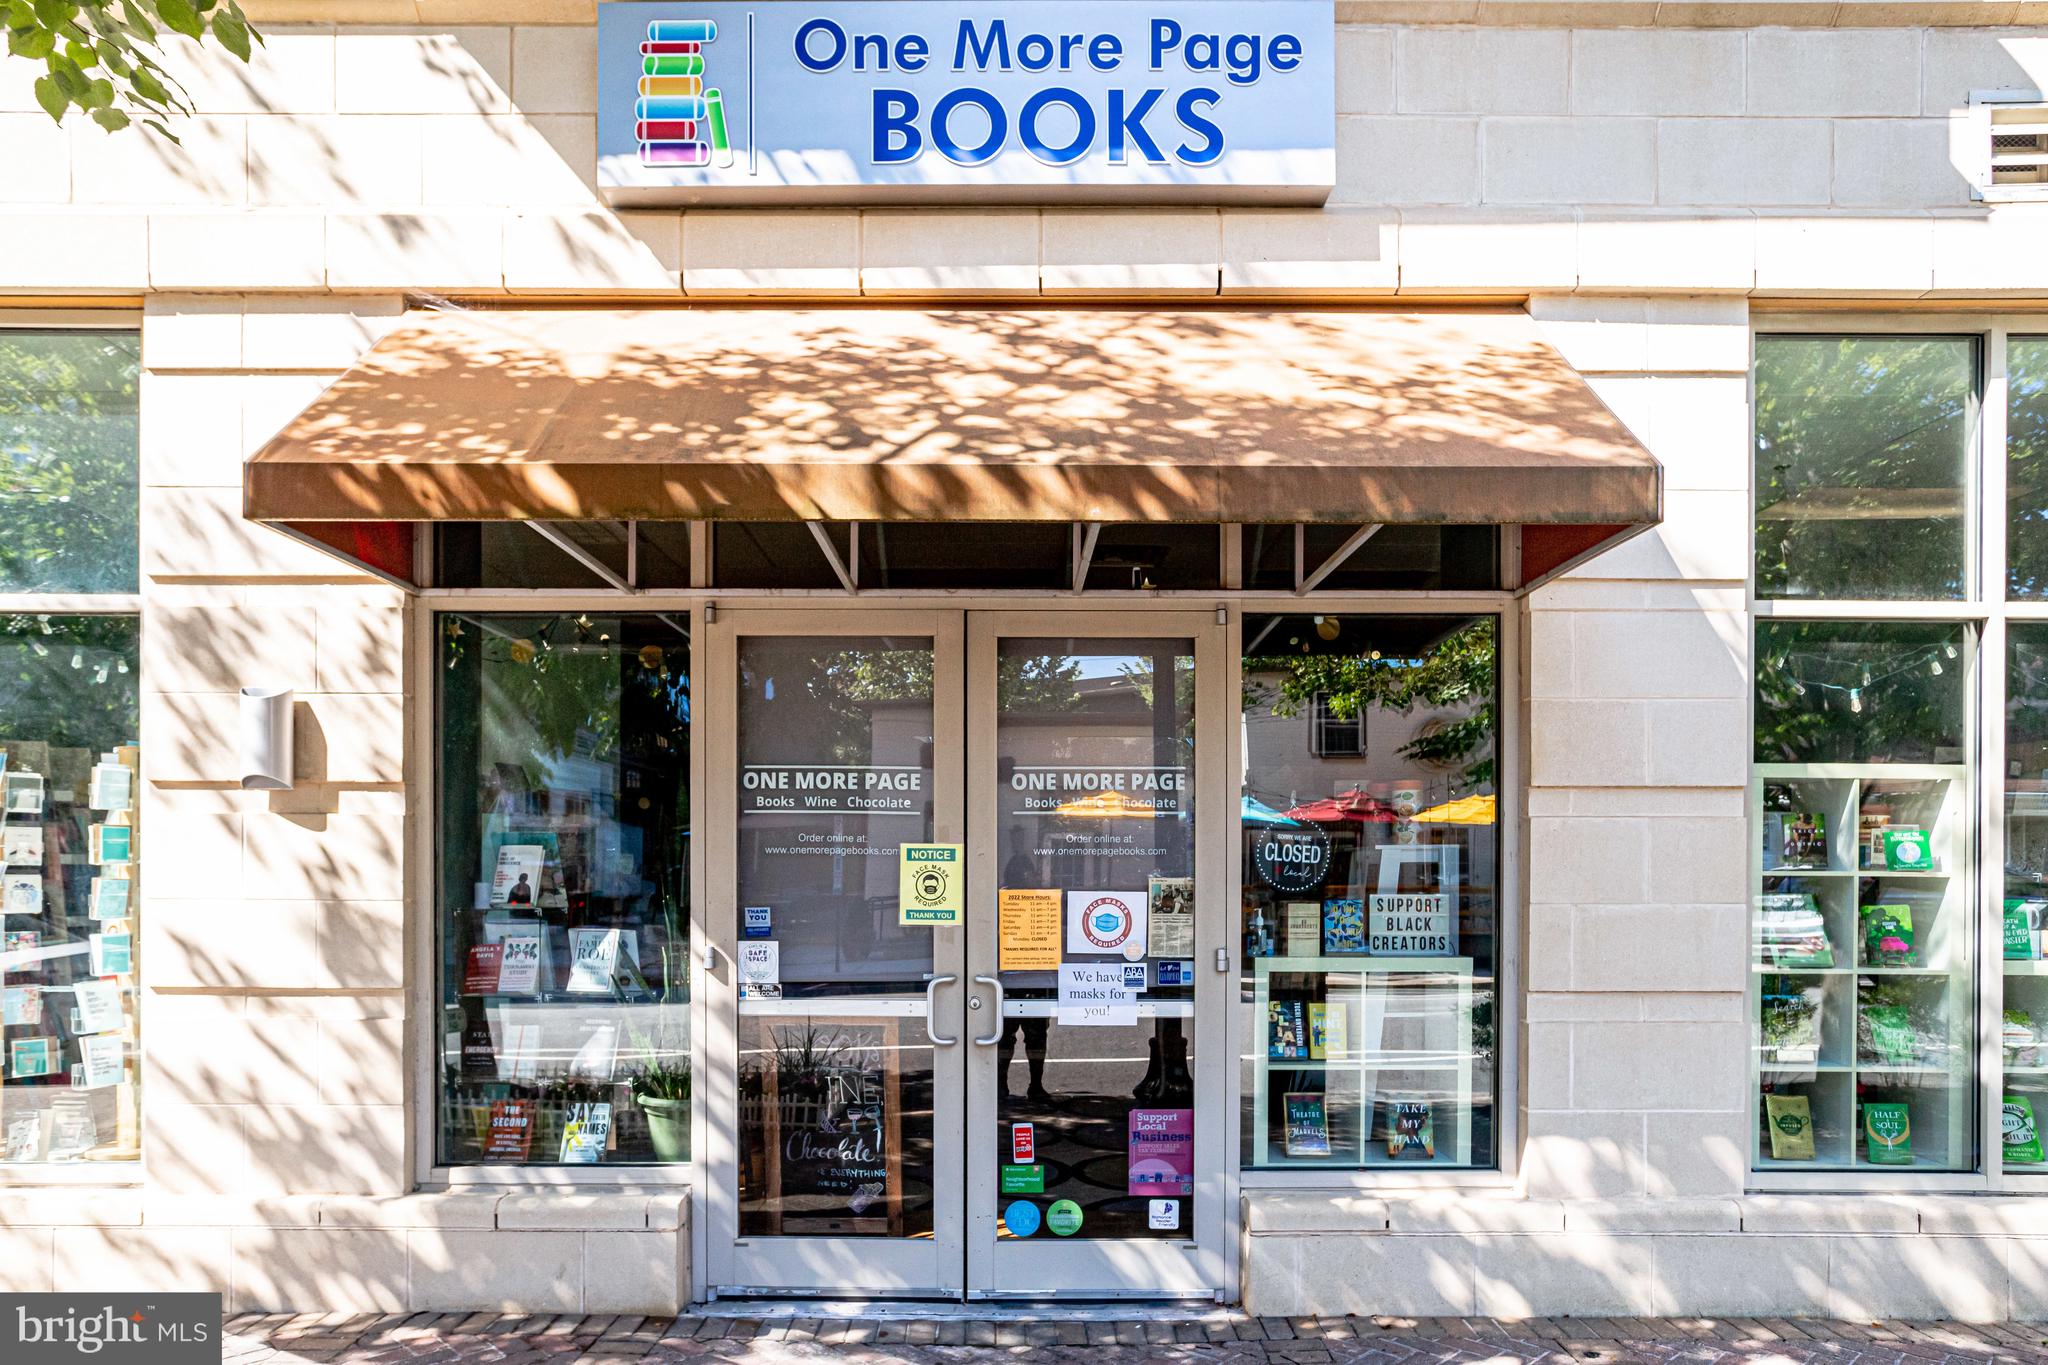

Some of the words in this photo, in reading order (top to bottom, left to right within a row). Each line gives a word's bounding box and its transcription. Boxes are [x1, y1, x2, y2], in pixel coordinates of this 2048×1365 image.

[794, 17, 931, 73] One
[952, 18, 1125, 73] More
[1148, 17, 1305, 86] Page
[870, 86, 1227, 167] BOOKS
[743, 772, 789, 790] ONE
[795, 772, 858, 790] MORE
[865, 773, 921, 791] PAGE
[1011, 773, 1056, 791] ONE
[1063, 773, 1125, 791] MORE
[1131, 773, 1186, 791] PAGE
[756, 796, 795, 807] Books
[804, 796, 837, 807] Wine
[847, 797, 911, 808] Chocolate
[1025, 797, 1062, 808] Books
[1072, 797, 1105, 808] Wine
[1115, 797, 1177, 808] Chocolate
[798, 833, 825, 843] Order
[826, 834, 854, 843] online
[1066, 834, 1092, 843] Order
[1094, 834, 1120, 843] online
[911, 850, 951, 860] NOTICE
[1033, 847, 1167, 857] www.onemorepagebooks.com
[1265, 842, 1321, 864] CLOSED
[912, 864, 929, 879] FACE
[931, 864, 950, 879] MASK
[1283, 865, 1311, 877] local
[913, 895, 947, 907] REQUIRED
[1086, 898, 1103, 914] FACE
[1105, 898, 1128, 914] MASKS
[1377, 898, 1440, 912] SUPPORT
[1387, 917, 1432, 931] BLACK
[1088, 935, 1125, 948] REQUIRED
[1372, 936, 1446, 950] CREATORS
[577, 947, 611, 960] ROE
[1072, 971, 1092, 982] We
[1096, 970, 1122, 982] have
[1124, 967, 1144, 977] ABA
[1069, 988, 1105, 999] masks
[1110, 987, 1126, 999] for
[1084, 1005, 1110, 1018] you!
[822, 1075, 884, 1105] INE,
[504, 1106, 520, 1114] THE
[566, 1103, 597, 1123] SAY
[1291, 1109, 1320, 1118] THEATRE
[1395, 1104, 1427, 1113] TAKE
[1137, 1112, 1177, 1123] Support
[1874, 1111, 1901, 1119] HALF
[492, 1118, 528, 1128] SECOND
[577, 1122, 607, 1135] NAMES
[1137, 1122, 1167, 1130] Local
[1402, 1119, 1421, 1128] MY
[1876, 1121, 1901, 1129] SOUL
[1132, 1131, 1191, 1143] Business
[1289, 1127, 1326, 1137] MARVELS
[1393, 1135, 1430, 1144] HAND
[831, 1168, 886, 1178] EVERYTHING
